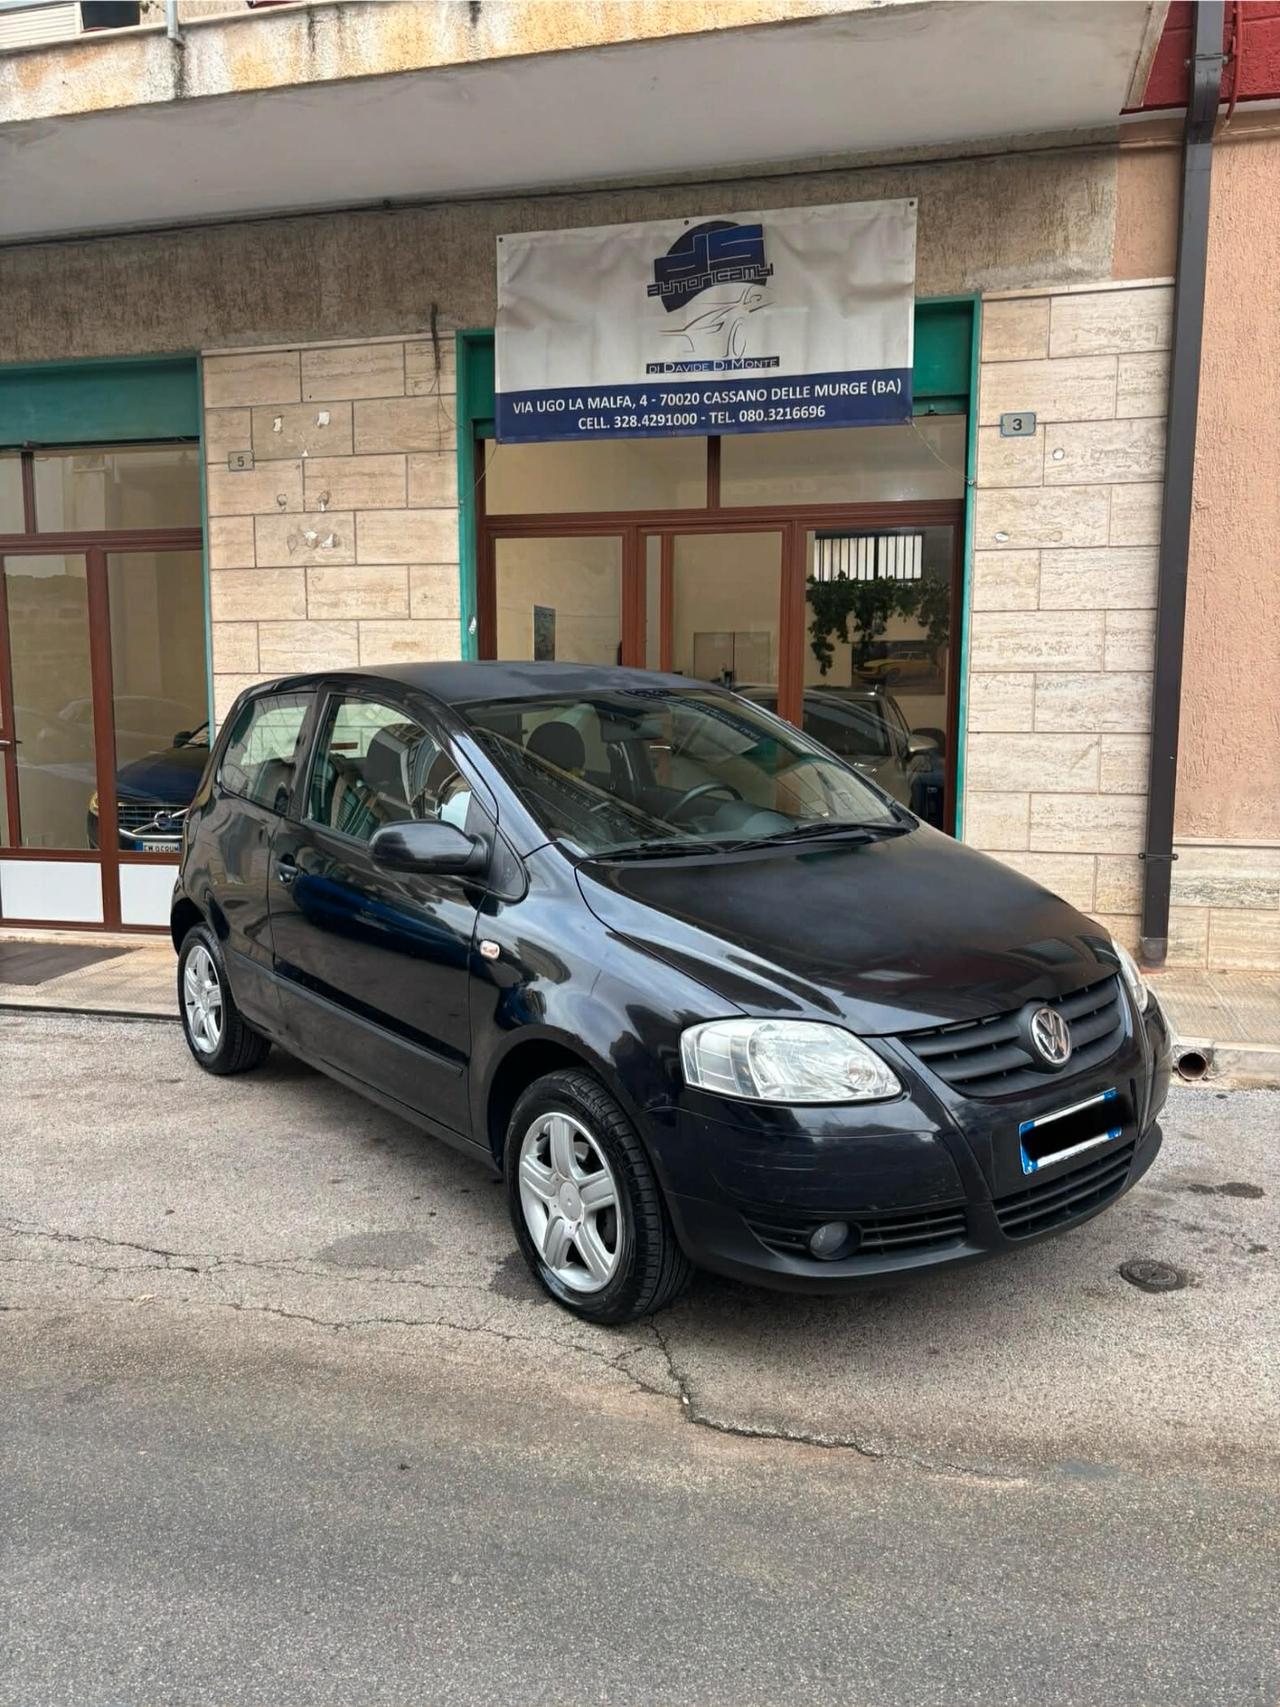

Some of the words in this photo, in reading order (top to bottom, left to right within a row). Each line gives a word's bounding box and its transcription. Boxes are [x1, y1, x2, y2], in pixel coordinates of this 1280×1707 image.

[664, 360, 709, 373] DAVIDE
[731, 357, 778, 369] MONTE
[512, 400, 534, 414] VIA
[536, 399, 565, 413] UGO
[568, 398, 584, 411] LA
[588, 395, 636, 409] MALFA,
[639, 394, 648, 406] 4
[659, 392, 700, 406] 70020
[703, 388, 768, 404] CASSANO
[771, 386, 811, 400] DELLE
[814, 381, 868, 397] MURGE
[871, 378, 902, 396] (BA)
[577, 416, 611, 430] CELL.
[613, 412, 698, 428] 328.4291000
[709, 411, 736, 424] TEL.
[739, 405, 826, 422] 080.3216696
[1012, 418, 1023, 431] 3
[237, 456, 245, 467] 5
